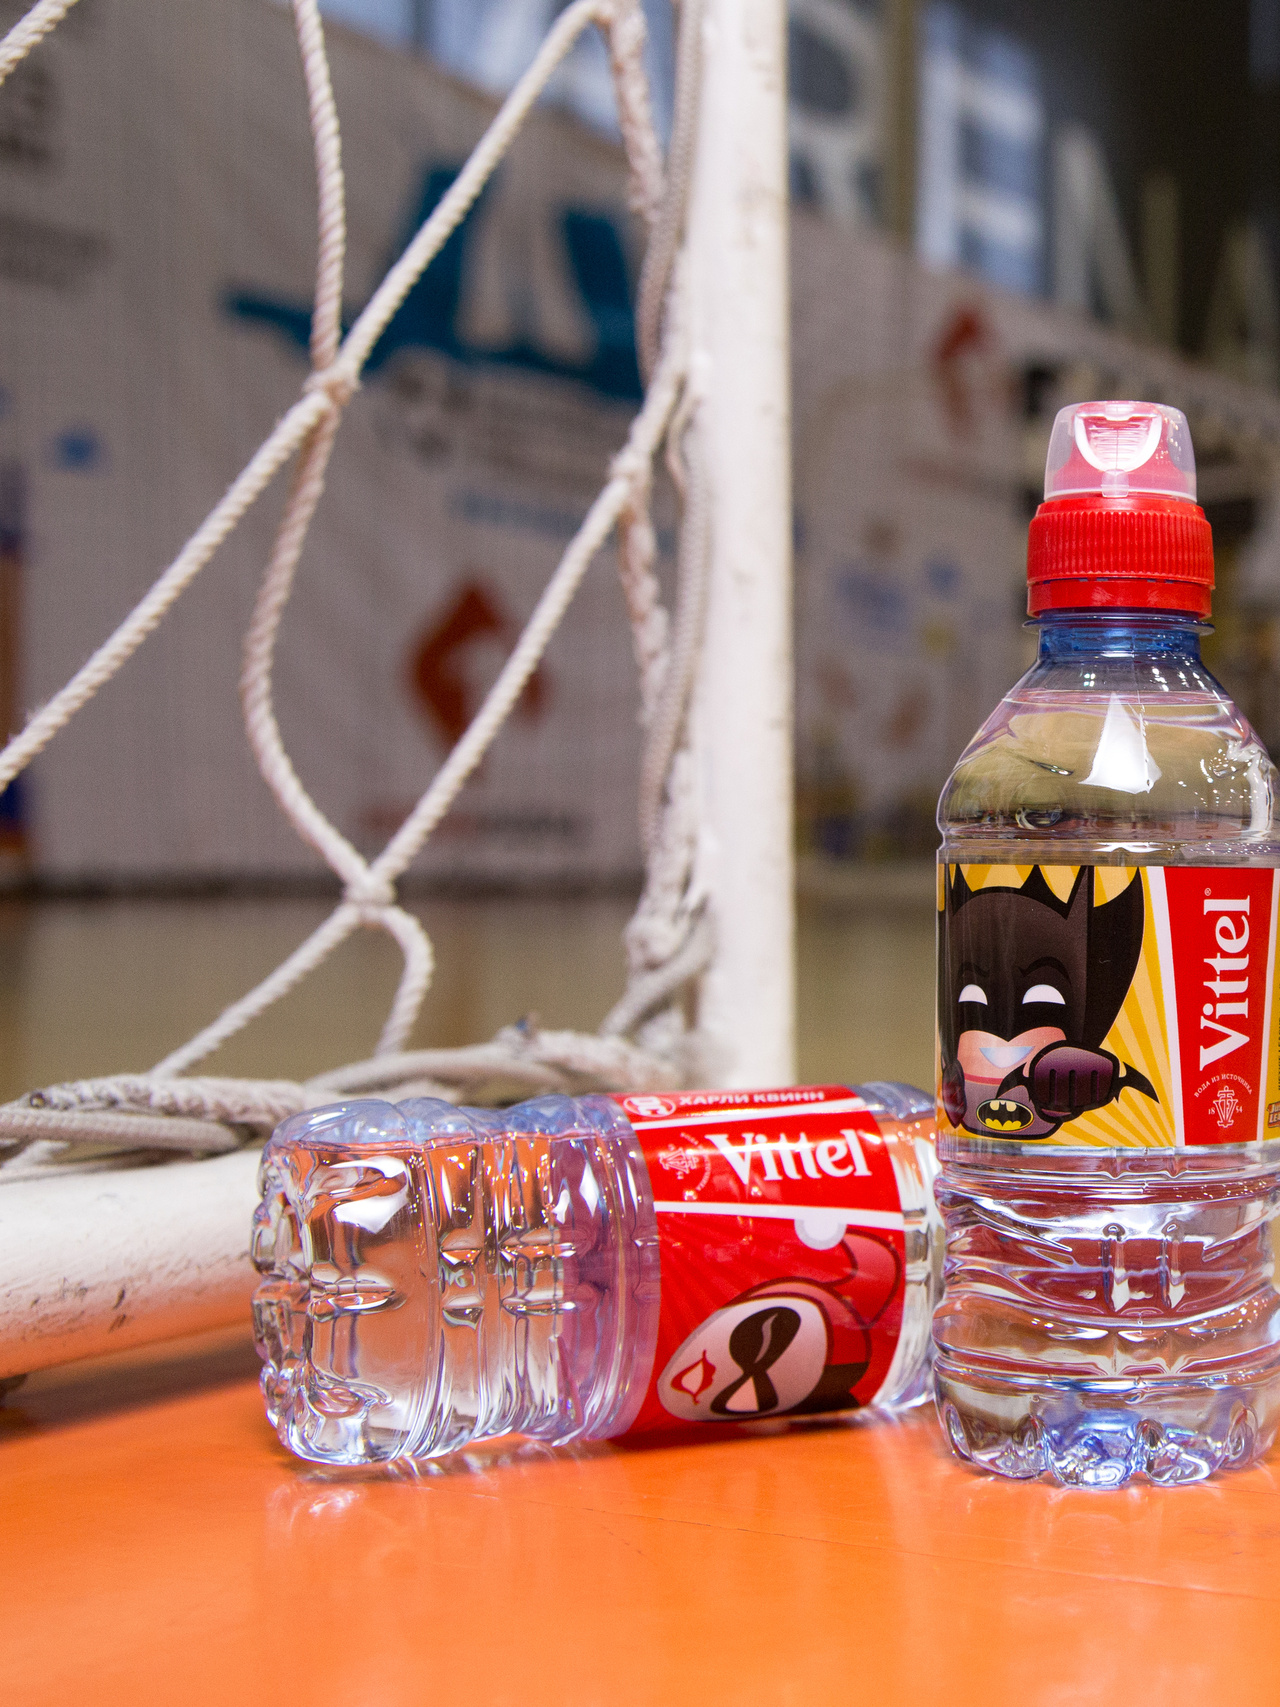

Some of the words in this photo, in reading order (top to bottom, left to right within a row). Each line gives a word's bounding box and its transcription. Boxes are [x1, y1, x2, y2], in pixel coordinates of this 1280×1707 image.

[1200, 895, 1250, 1071] Vittel
[679, 1094, 749, 1106] ХАРЛИ
[753, 1091, 825, 1103] КВИНН
[1193, 1080, 1211, 1098] ВОДА
[1211, 1075, 1220, 1083] ИЗ
[1221, 1073, 1253, 1095] ИСТОЧНИКА
[704, 1129, 873, 1185] Vittel
